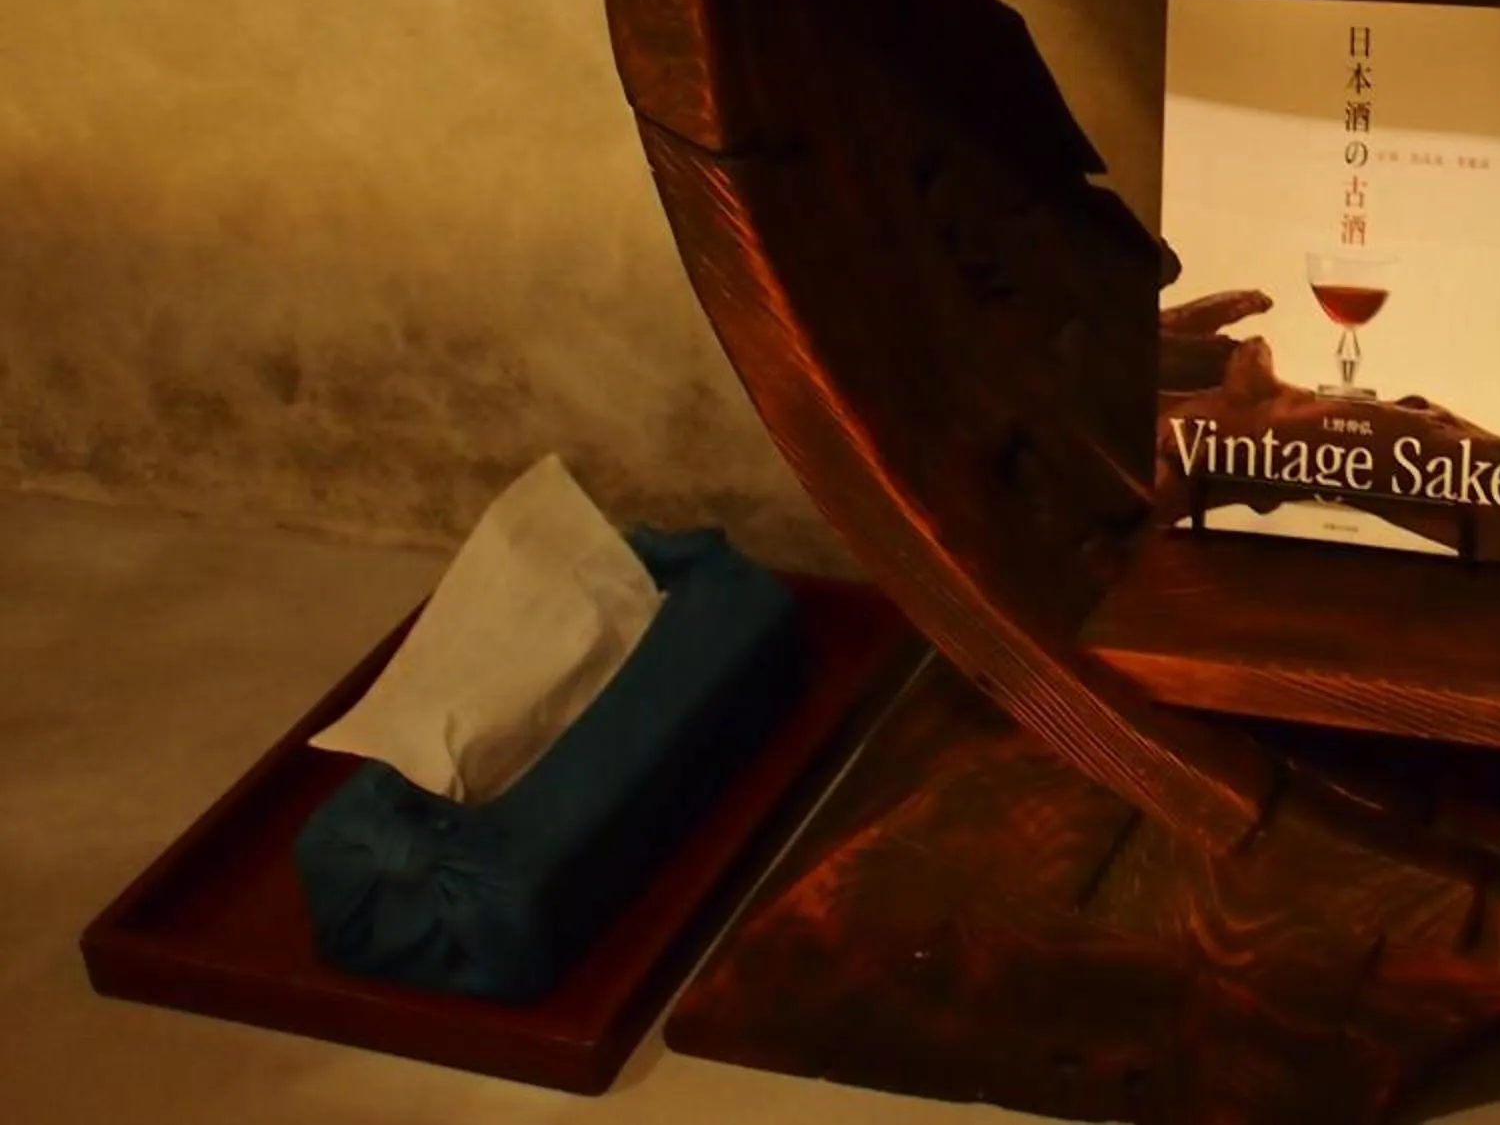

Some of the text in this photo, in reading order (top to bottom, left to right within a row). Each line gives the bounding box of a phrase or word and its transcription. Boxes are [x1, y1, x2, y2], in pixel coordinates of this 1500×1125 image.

[1341, 26, 1372, 246] 日本酒の古酒
[1169, 418, 1374, 503] Vintage
